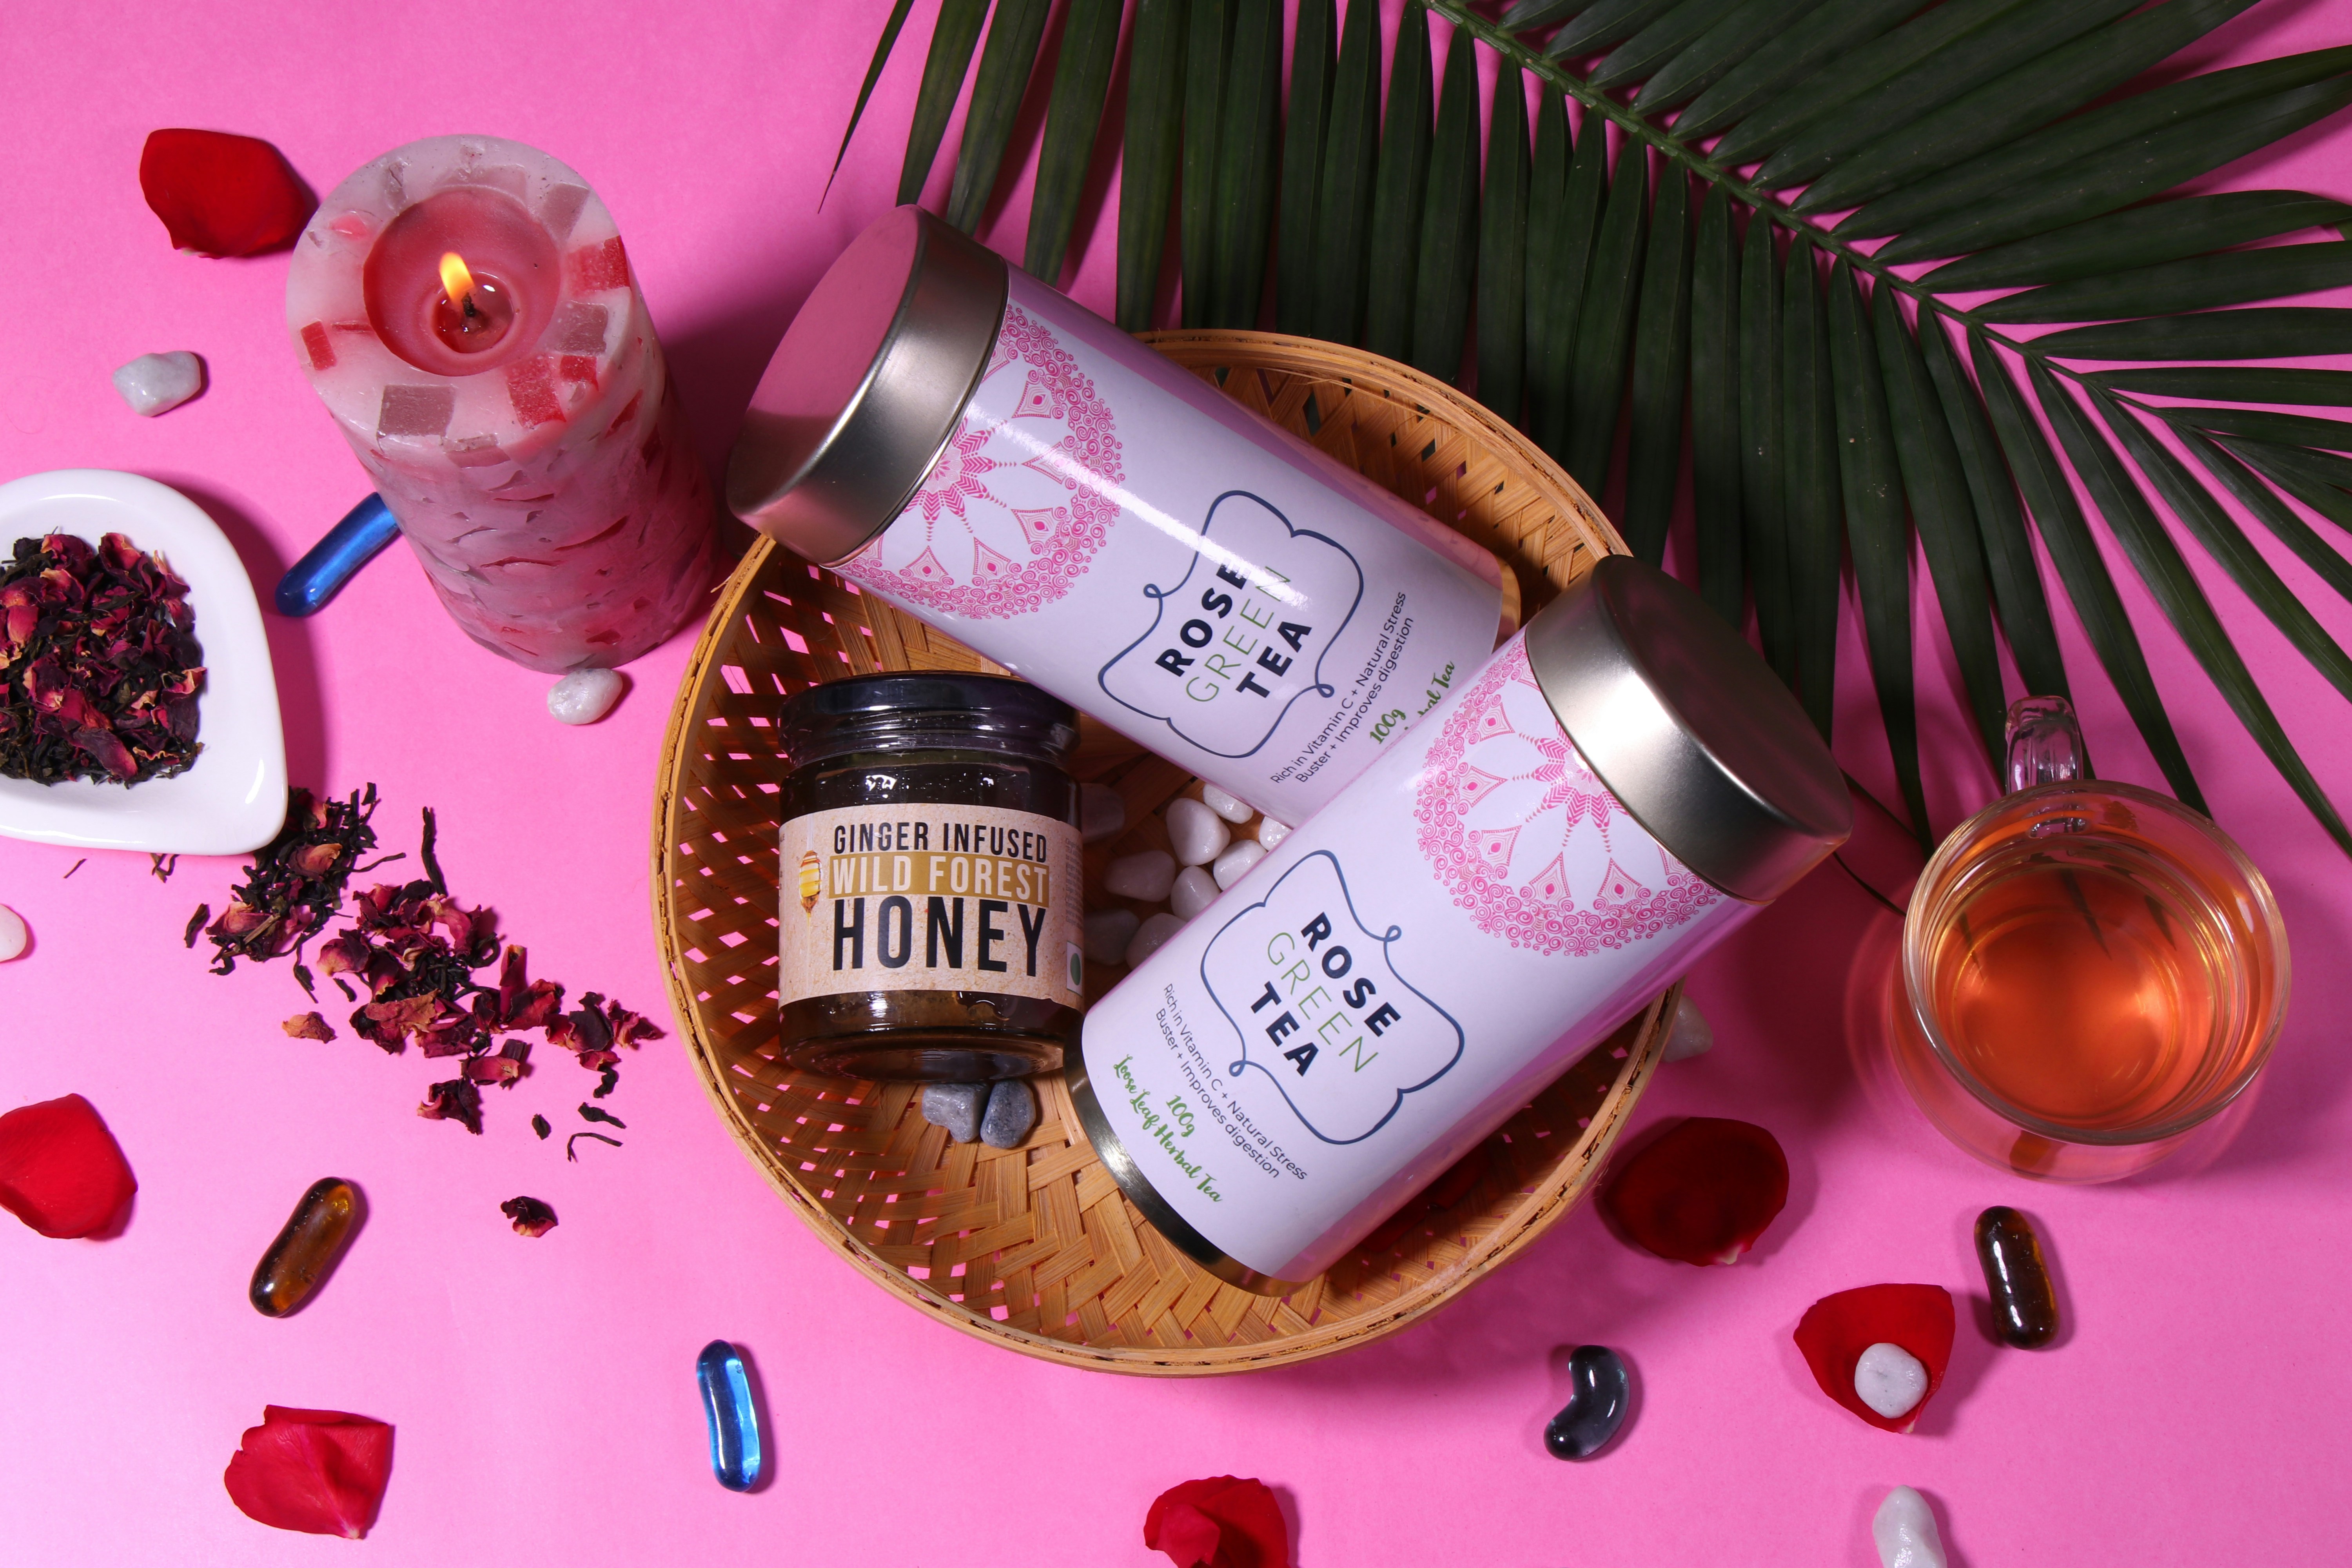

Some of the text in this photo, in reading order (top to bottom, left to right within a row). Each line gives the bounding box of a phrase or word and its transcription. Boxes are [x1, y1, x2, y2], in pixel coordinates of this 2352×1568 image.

[1155, 558, 1251, 677] ROSE
[1186, 566, 1290, 702] GREEN
[1236, 621, 1312, 698] TEA
[1431, 661, 1455, 688] Tea
[1270, 764, 1297, 783] Rich
[1292, 755, 1307, 766] in
[1302, 711, 1346, 755] Vitamin
[1341, 698, 1353, 710] C
[1355, 633, 1390, 687] Natural
[1383, 592, 1406, 633] Stress
[1296, 752, 1331, 782] Buster
[1335, 683, 1381, 744] Improves
[1378, 617, 1414, 682] digestion
[1370, 709, 1406, 744] 100g
[833, 855, 912, 895] WILD
[929, 855, 1048, 904] FOREST
[834, 822, 1047, 863] GINGER INFUSED
[833, 896, 1046, 977] HONEY
[1301, 912, 1401, 1037] ROSE
[1250, 981, 1319, 1076] TEA
[1267, 932, 1378, 1073] GREEN
[1113, 1054, 1223, 1202] Loose Leaf Herbal Tea
[1156, 1007, 1179, 1051] Buster
[1180, 1060, 1227, 1124] Improves
[1225, 1123, 1279, 1178] digestion
[1163, 984, 1177, 1010] Rich
[1171, 1010, 1182, 1026] in
[1181, 1024, 1212, 1079] Vitamin
[1211, 1079, 1223, 1091] C
[1228, 1100, 1273, 1149] Natural
[1269, 1146, 1307, 1180] Stress
[1166, 1095, 1195, 1138] 100g
